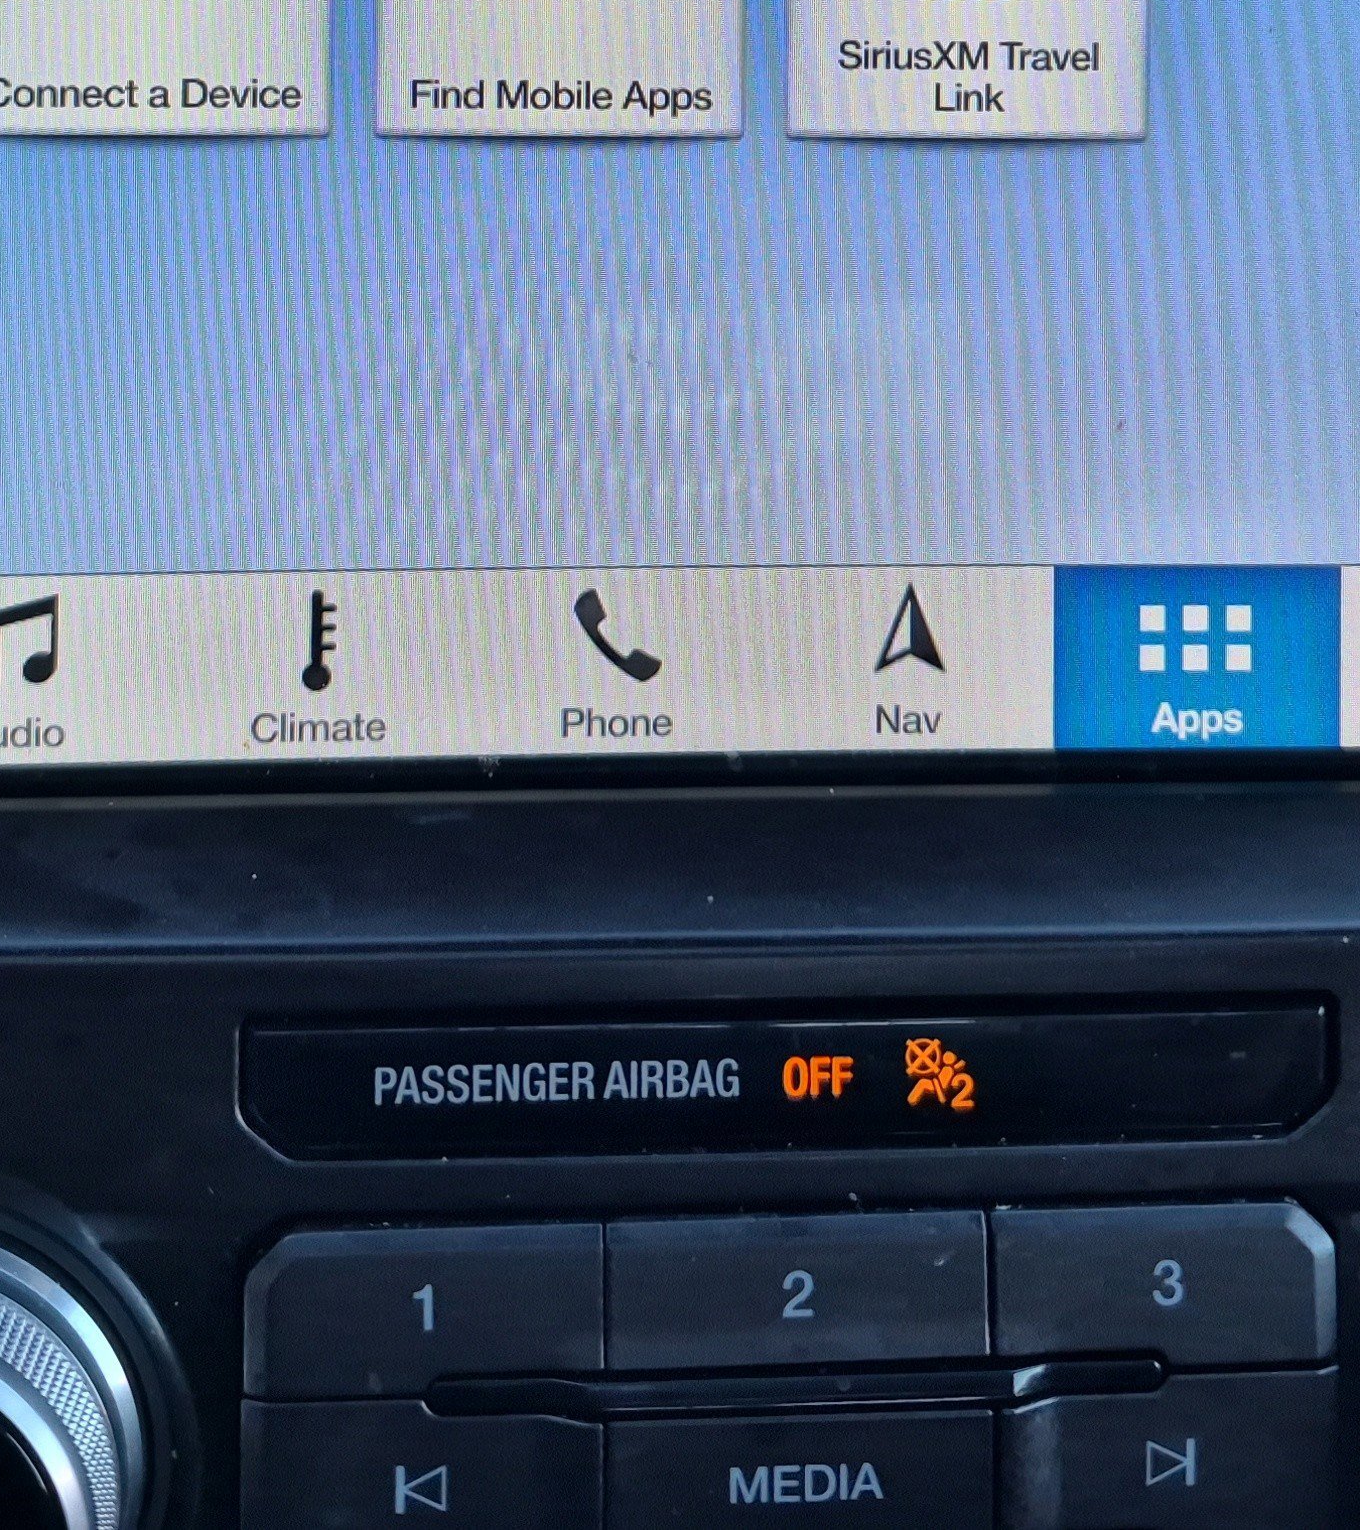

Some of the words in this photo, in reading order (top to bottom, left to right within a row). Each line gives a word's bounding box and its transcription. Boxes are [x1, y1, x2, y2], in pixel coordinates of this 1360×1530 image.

[838, 40, 989, 72] SiriusXM
[998, 42, 1100, 73] Travel
[148, 86, 170, 111] a
[180, 79, 302, 109] Device
[410, 79, 485, 111] Find
[496, 79, 614, 111] Mobile
[622, 81, 713, 117] Apps
[933, 82, 1005, 113] Link
[251, 712, 388, 743] Climate
[561, 707, 673, 739] Phone
[875, 704, 942, 736] Nav
[1151, 702, 1244, 743] Apps
[373, 1061, 596, 1106] PASSENGER
[603, 1058, 740, 1100] AIRBAG
[782, 1056, 854, 1099] OFF
[781, 1270, 815, 1318] 2
[1151, 1258, 1184, 1306] 3
[412, 1284, 436, 1330] 1
[728, 1463, 883, 1506] MEDIA
